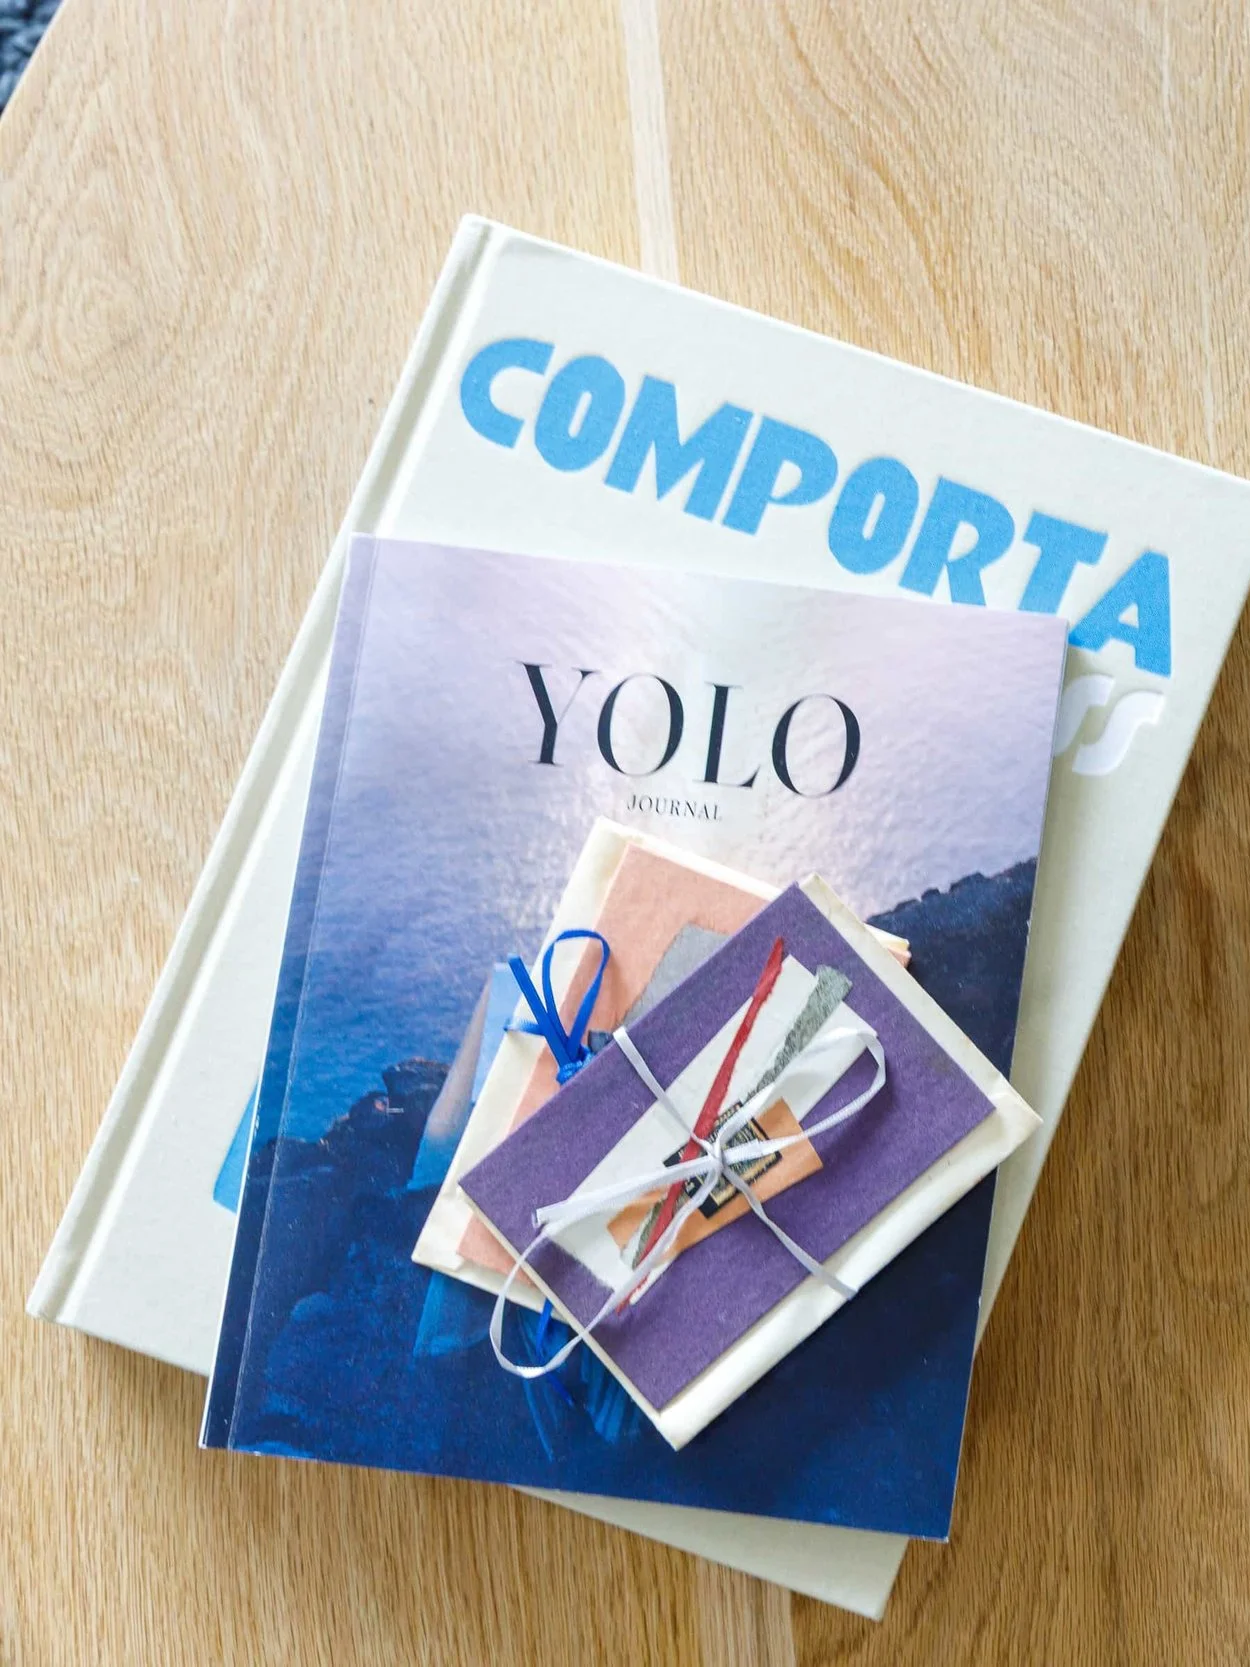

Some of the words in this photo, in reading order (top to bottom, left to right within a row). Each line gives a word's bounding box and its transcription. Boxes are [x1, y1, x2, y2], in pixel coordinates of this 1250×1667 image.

[460, 338, 1172, 678] COMPORTA
[516, 661, 861, 799] YOLO
[626, 794, 723, 821] JOURNAL
